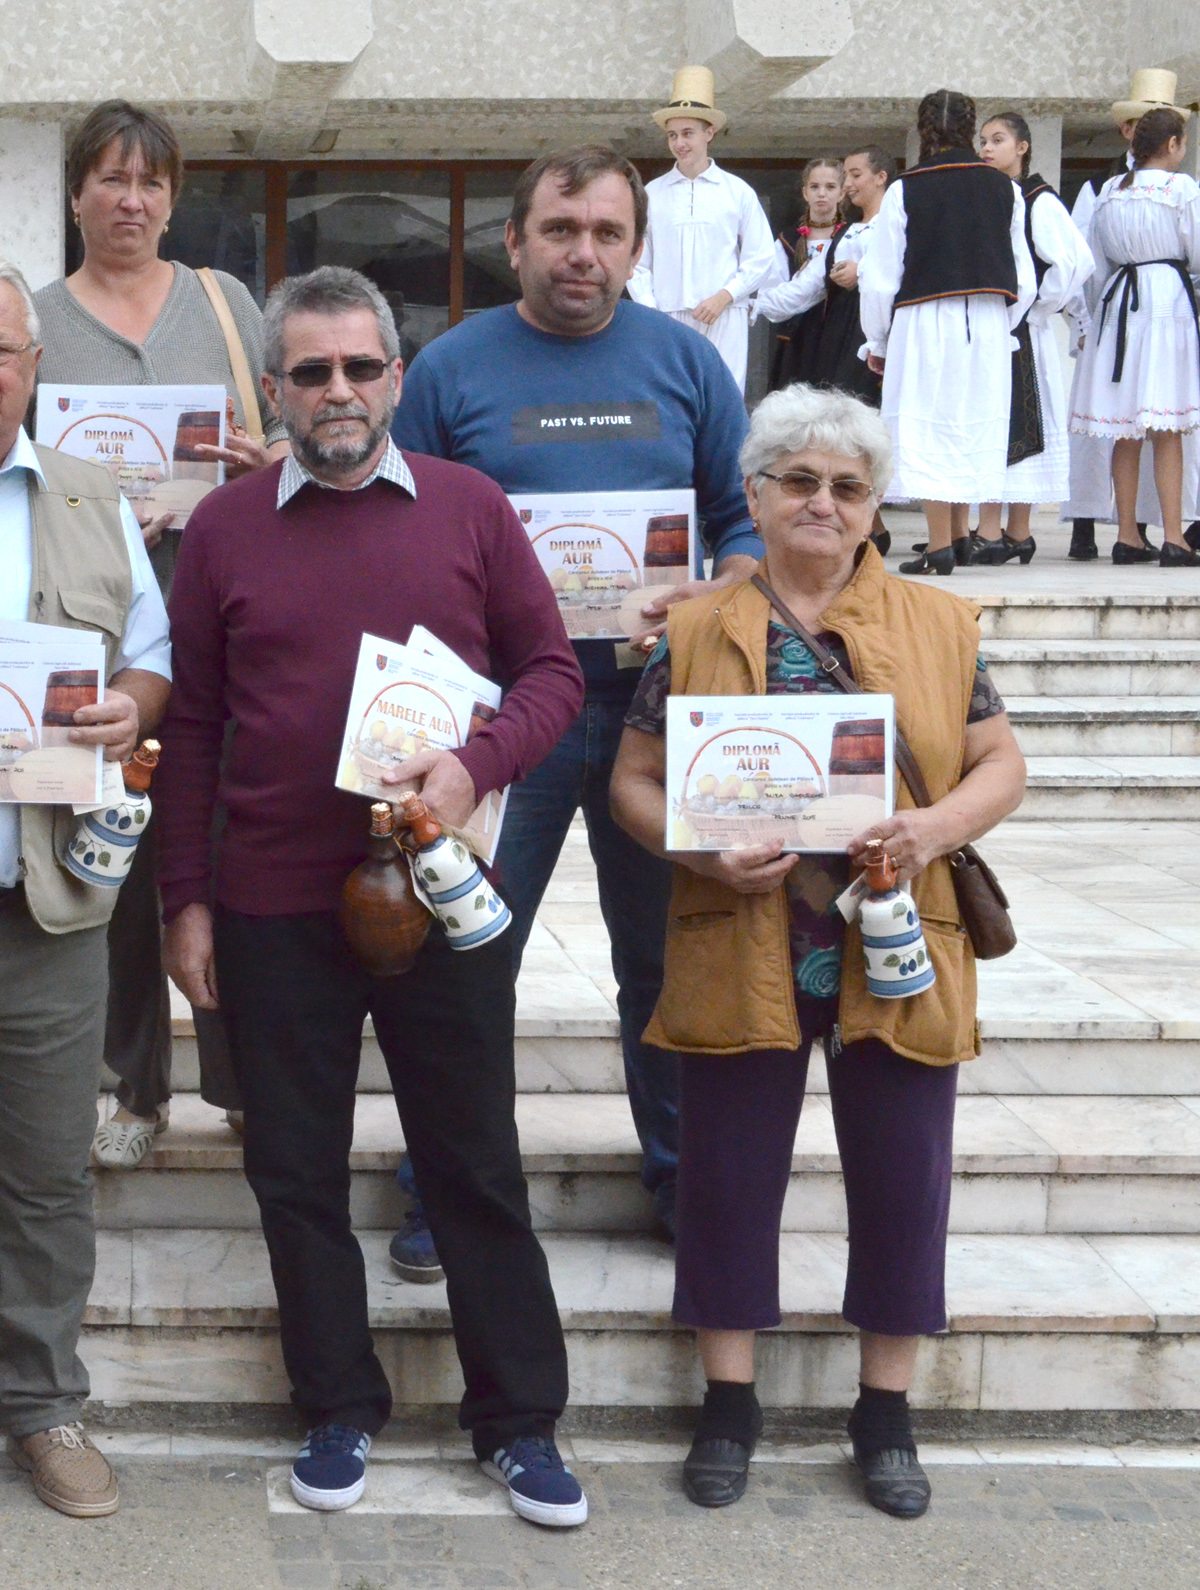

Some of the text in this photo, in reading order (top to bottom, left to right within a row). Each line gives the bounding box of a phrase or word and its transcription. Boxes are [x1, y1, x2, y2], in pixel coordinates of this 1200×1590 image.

[540, 415, 632, 427] PAST VS. FUTURE
[95, 442, 124, 455] AUR
[562, 552, 593, 565] AUR
[376, 699, 452, 735] MARELE AUR
[736, 757, 770, 771] AUR
